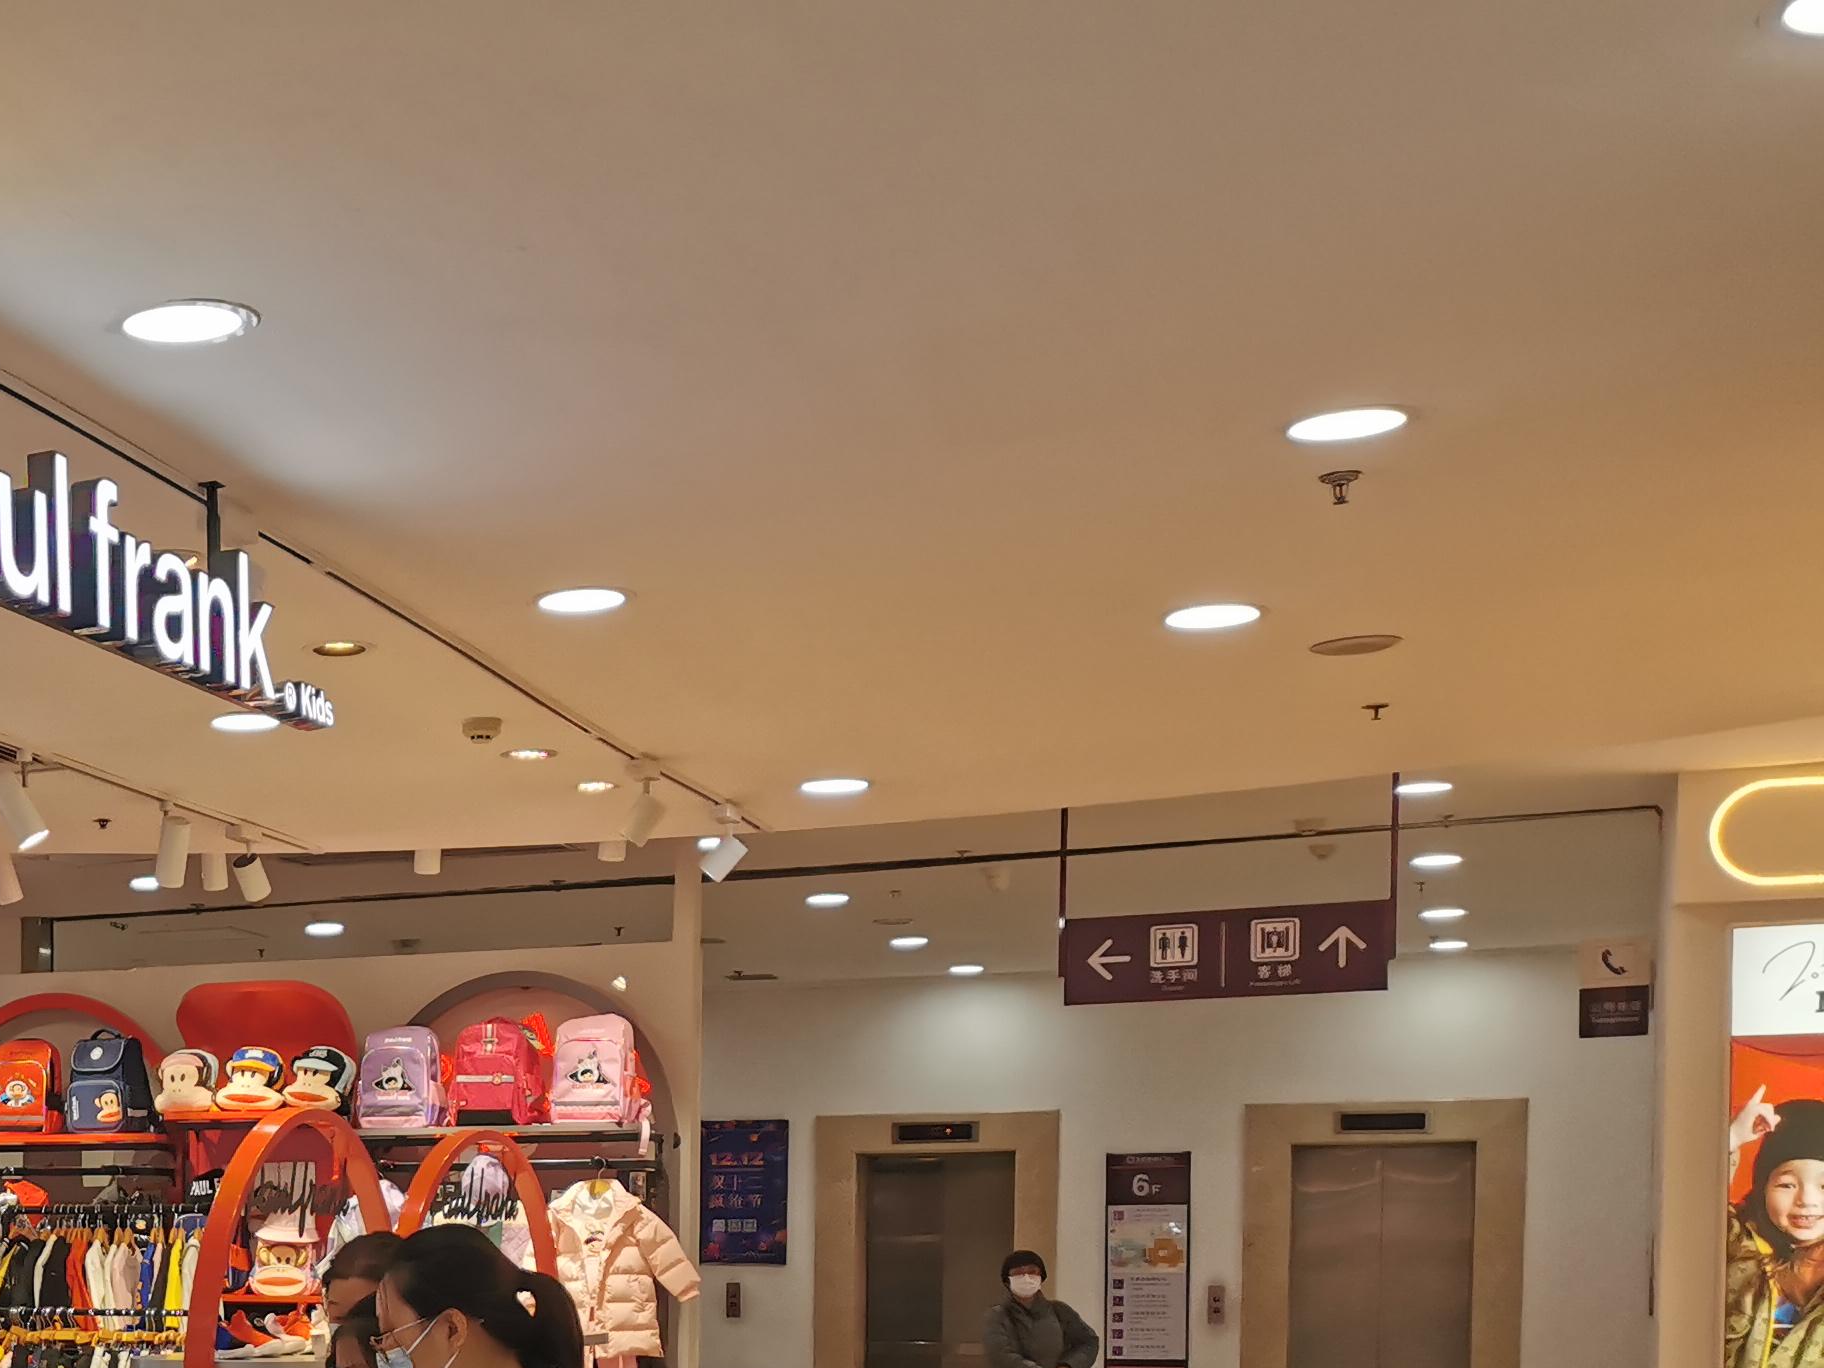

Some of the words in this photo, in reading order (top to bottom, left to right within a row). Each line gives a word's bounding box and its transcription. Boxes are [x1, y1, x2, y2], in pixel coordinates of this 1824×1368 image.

[88, 477, 276, 702] frank
[300, 680, 335, 728] Kids
[1149, 968, 1199, 984] 洗手间
[712, 1174, 765, 1190] 双十二
